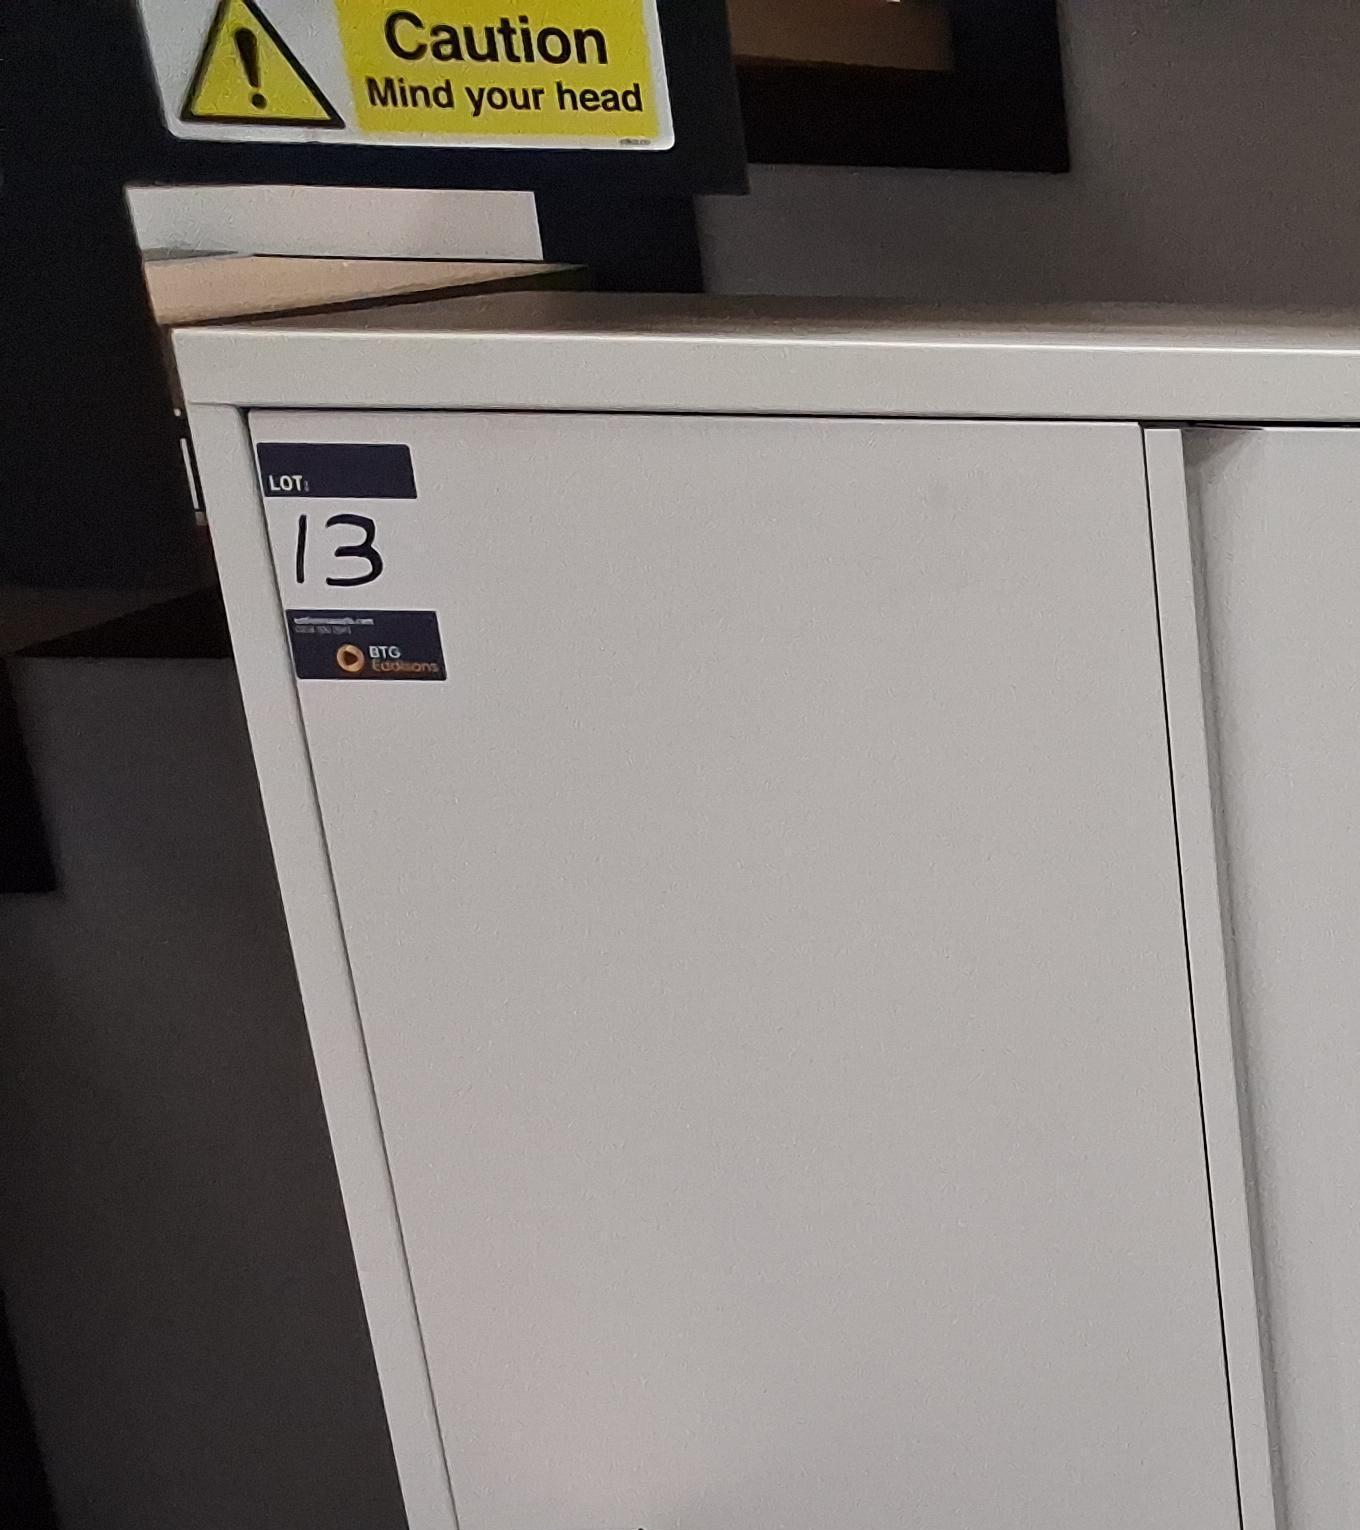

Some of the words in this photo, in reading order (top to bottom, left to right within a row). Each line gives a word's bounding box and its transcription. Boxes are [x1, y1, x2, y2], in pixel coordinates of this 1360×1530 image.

[383, 9, 609, 65] Caution
[365, 75, 455, 109] Mind
[465, 85, 545, 117] your
[555, 80, 643, 113] head
[268, 474, 309, 492] LOT:
[296, 513, 384, 587] 13
[368, 645, 401, 659] BTG
